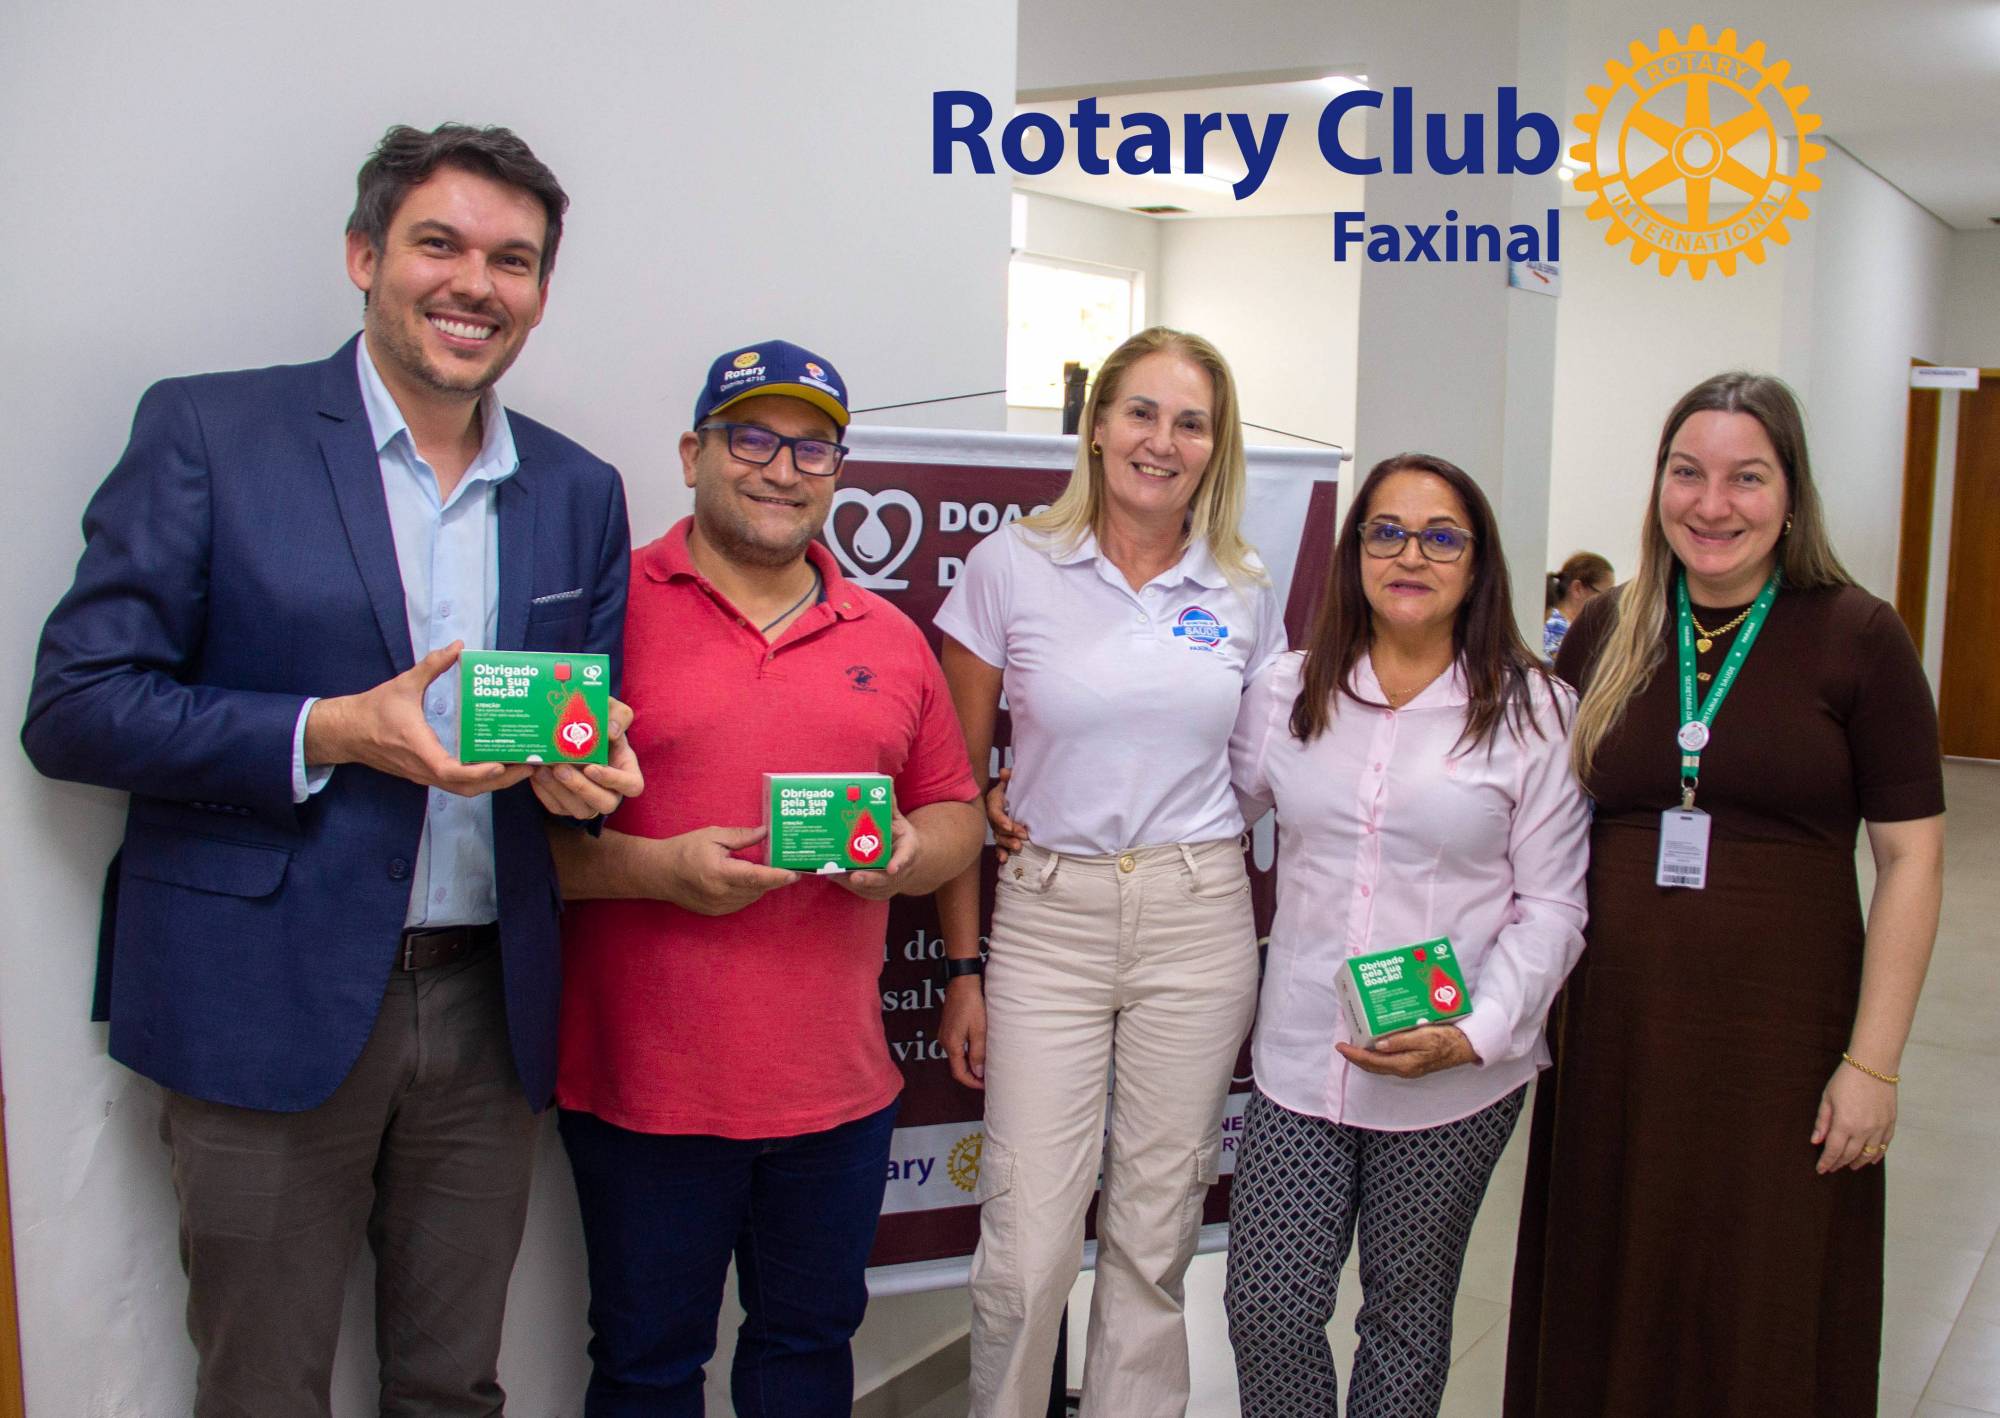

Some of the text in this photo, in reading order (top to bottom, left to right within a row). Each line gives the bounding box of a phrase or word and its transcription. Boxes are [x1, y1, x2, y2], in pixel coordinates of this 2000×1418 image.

[724, 366, 766, 380] Rotary
[474, 664, 538, 678] Obrigado
[474, 676, 530, 687] pela sua
[474, 685, 528, 698] doação!
[781, 789, 834, 800] Obrigado
[781, 799, 805, 808] pela
[781, 806, 826, 818] doação!
[1358, 956, 1404, 972] Obrigado
[1361, 968, 1382, 981] pela
